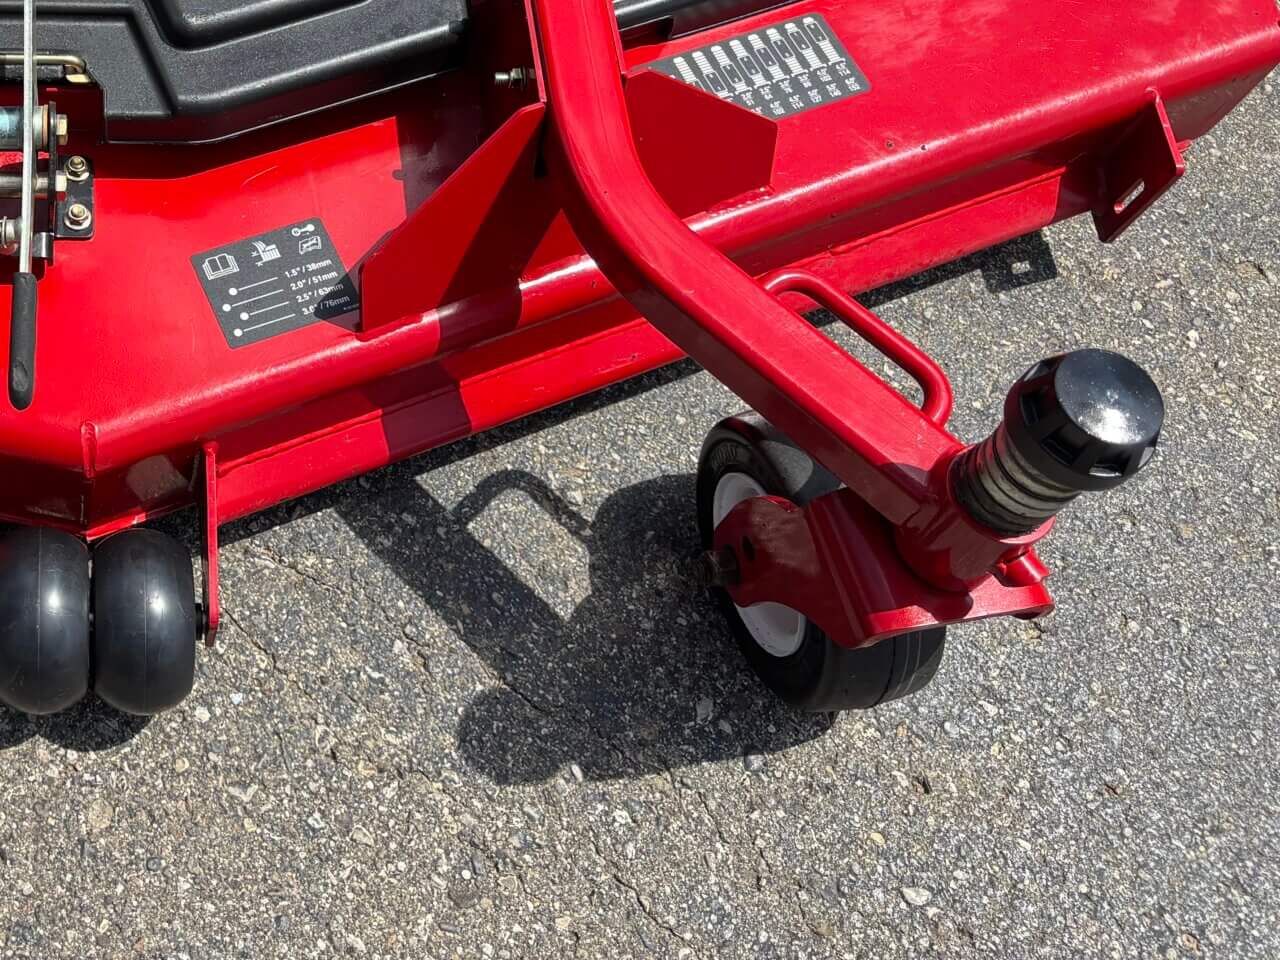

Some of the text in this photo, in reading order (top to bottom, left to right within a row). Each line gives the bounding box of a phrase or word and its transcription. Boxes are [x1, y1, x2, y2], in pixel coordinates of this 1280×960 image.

[290, 279, 306, 291] 2.0"
[312, 271, 338, 283] 51mm
[296, 291, 312, 303] 2.5"
[324, 295, 350, 308] 76mm
